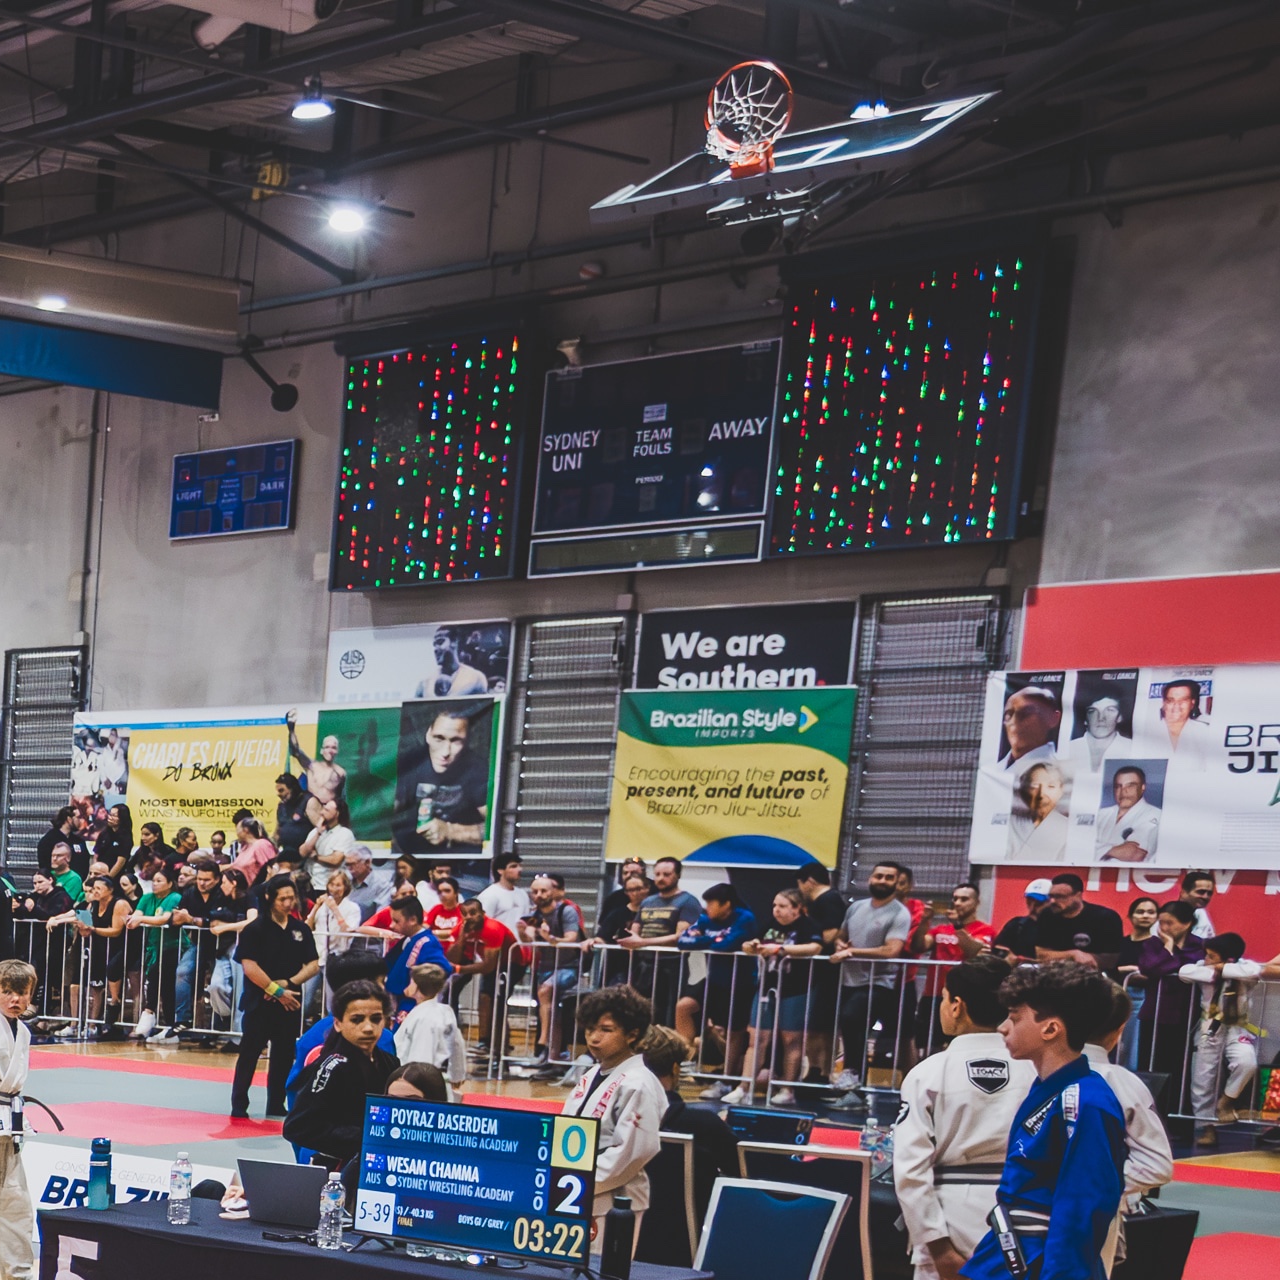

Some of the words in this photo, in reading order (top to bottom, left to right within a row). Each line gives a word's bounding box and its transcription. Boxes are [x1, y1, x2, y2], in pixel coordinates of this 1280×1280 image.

[636, 427, 672, 443] TEAM
[708, 417, 768, 441] AWAY
[544, 430, 601, 452] SYDNEY
[633, 443, 672, 457] FOULS
[552, 452, 582, 472] UNI
[260, 481, 285, 492] DARK
[176, 490, 202, 502] LIGHT
[661, 632, 718, 660] We
[726, 633, 786, 656] are
[657, 663, 826, 689] Southern.
[650, 709, 738, 728] Brazilian
[742, 708, 797, 731] Style
[695, 729, 756, 739] IMPORTS
[132, 742, 211, 769] CHARLES
[211, 740, 281, 767] OLIVEIRA
[189, 758, 236, 782] BRONX
[628, 766, 740, 786] Encouraging
[745, 767, 774, 781] the
[779, 767, 829, 786] past,
[626, 785, 700, 801] present,
[705, 784, 741, 799] and
[745, 784, 805, 799] future
[810, 784, 830, 800] of
[140, 799, 178, 808] MOST
[179, 798, 264, 808] SUBMISSION
[647, 801, 719, 816] Brazilian
[722, 801, 802, 818] Jiu-Jitsu.
[139, 808, 173, 818] WINS
[176, 809, 190, 818] IN
[191, 809, 215, 818] UFC
[391, 1108, 435, 1128] POYRAZ
[437, 1113, 498, 1135] BASERDEM
[542, 1123, 548, 1137] 1
[369, 1125, 385, 1137] AUS
[402, 1128, 432, 1143] SYDNEY
[433, 1132, 477, 1148] WRESTLING
[479, 1138, 519, 1153] ACADEMY
[562, 1125, 586, 1162] 0
[538, 1146, 548, 1161] 0
[118, 1170, 169, 1186] GENERAL
[387, 1155, 427, 1176] WESAM
[429, 1161, 480, 1183] CHAMMA
[365, 1172, 381, 1184] AUS
[397, 1176, 428, 1191] SYDNEY
[429, 1181, 473, 1197] WRESTLING
[474, 1187, 514, 1202] ACADEMY
[535, 1173, 545, 1188] 0
[533, 1196, 543, 1211] 0
[554, 1174, 582, 1215] 2
[359, 1201, 391, 1223] 5-39
[425, 1210, 434, 1219] KG
[397, 1217, 413, 1227] FINAL
[458, 1214, 473, 1225] BOYS
[474, 1217, 481, 1226] GI
[487, 1218, 503, 1230] GREY
[513, 1217, 585, 1258] 03:22
